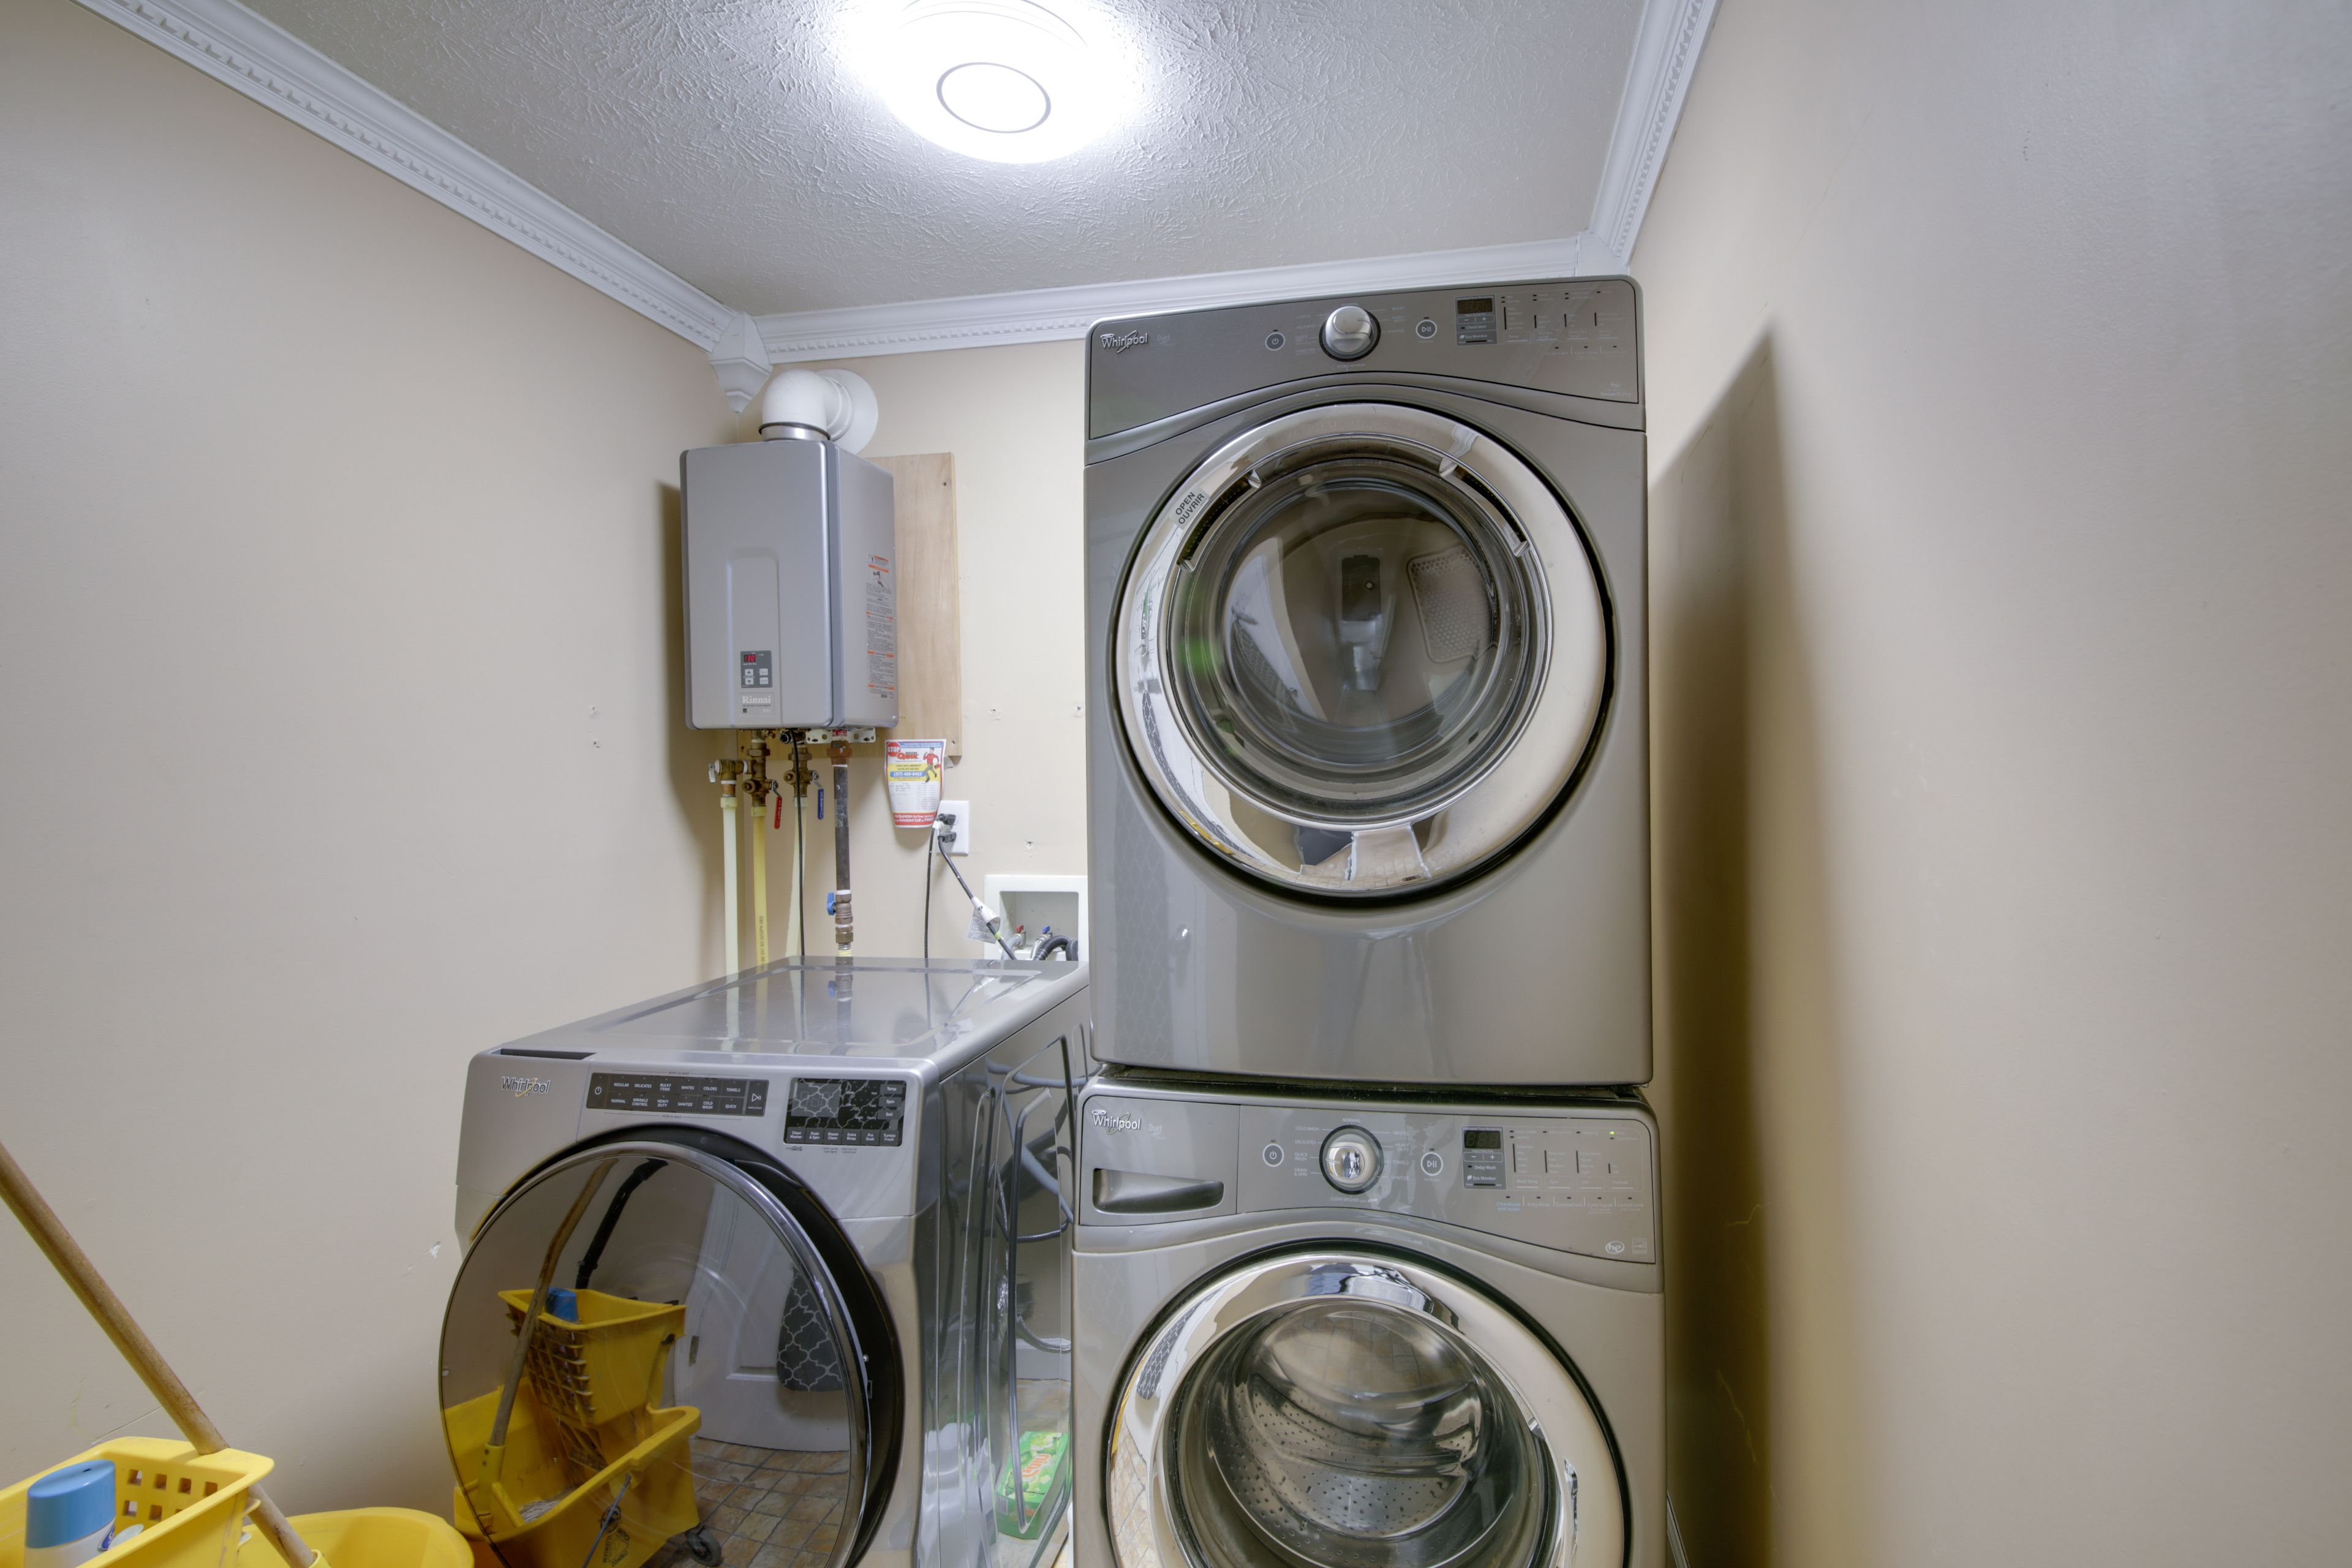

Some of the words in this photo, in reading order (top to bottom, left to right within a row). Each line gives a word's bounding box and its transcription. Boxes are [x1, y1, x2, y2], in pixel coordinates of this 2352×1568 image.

[1101, 333, 1148, 350] Whirlpool
[1175, 492, 1196, 515] OPEN
[1178, 494, 1205, 524] OUVRIR
[502, 1076, 551, 1096] Whirlpool
[1093, 1114, 1141, 1132] Whirlpool
[1148, 1123, 1163, 1133] Duet
